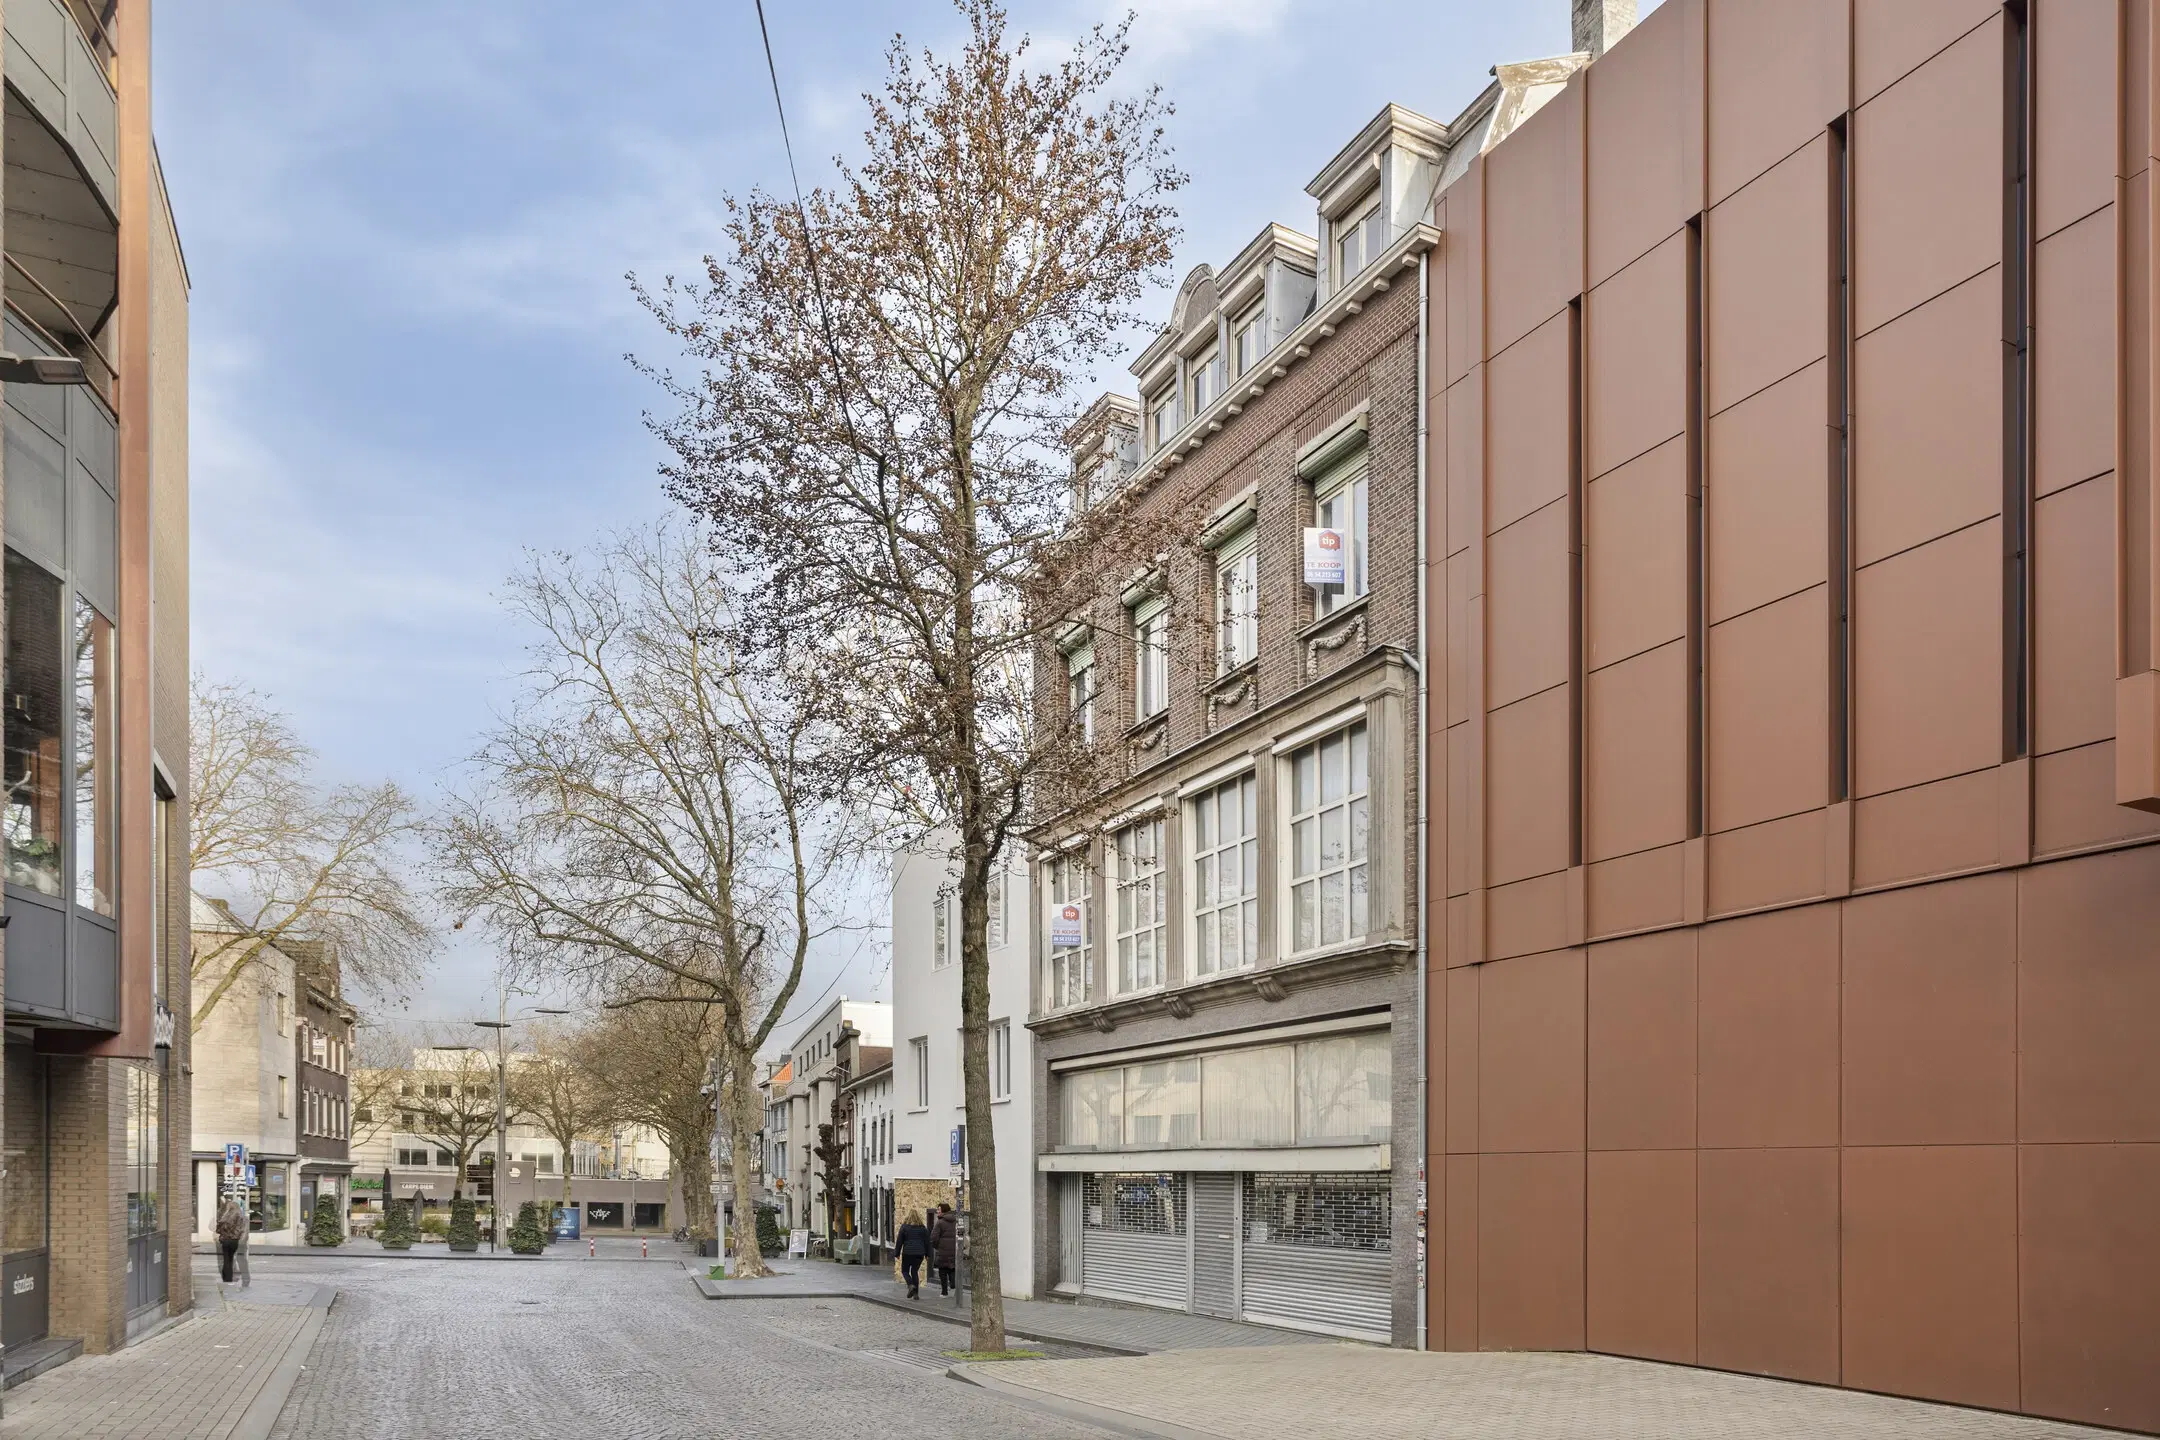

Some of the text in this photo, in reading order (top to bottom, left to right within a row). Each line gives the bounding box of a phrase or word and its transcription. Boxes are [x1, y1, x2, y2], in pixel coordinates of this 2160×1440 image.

[1321, 536, 1335, 546] tip
[1065, 910, 1075, 918] tip
[952, 1132, 957, 1149] P
[229, 1145, 240, 1156] P
